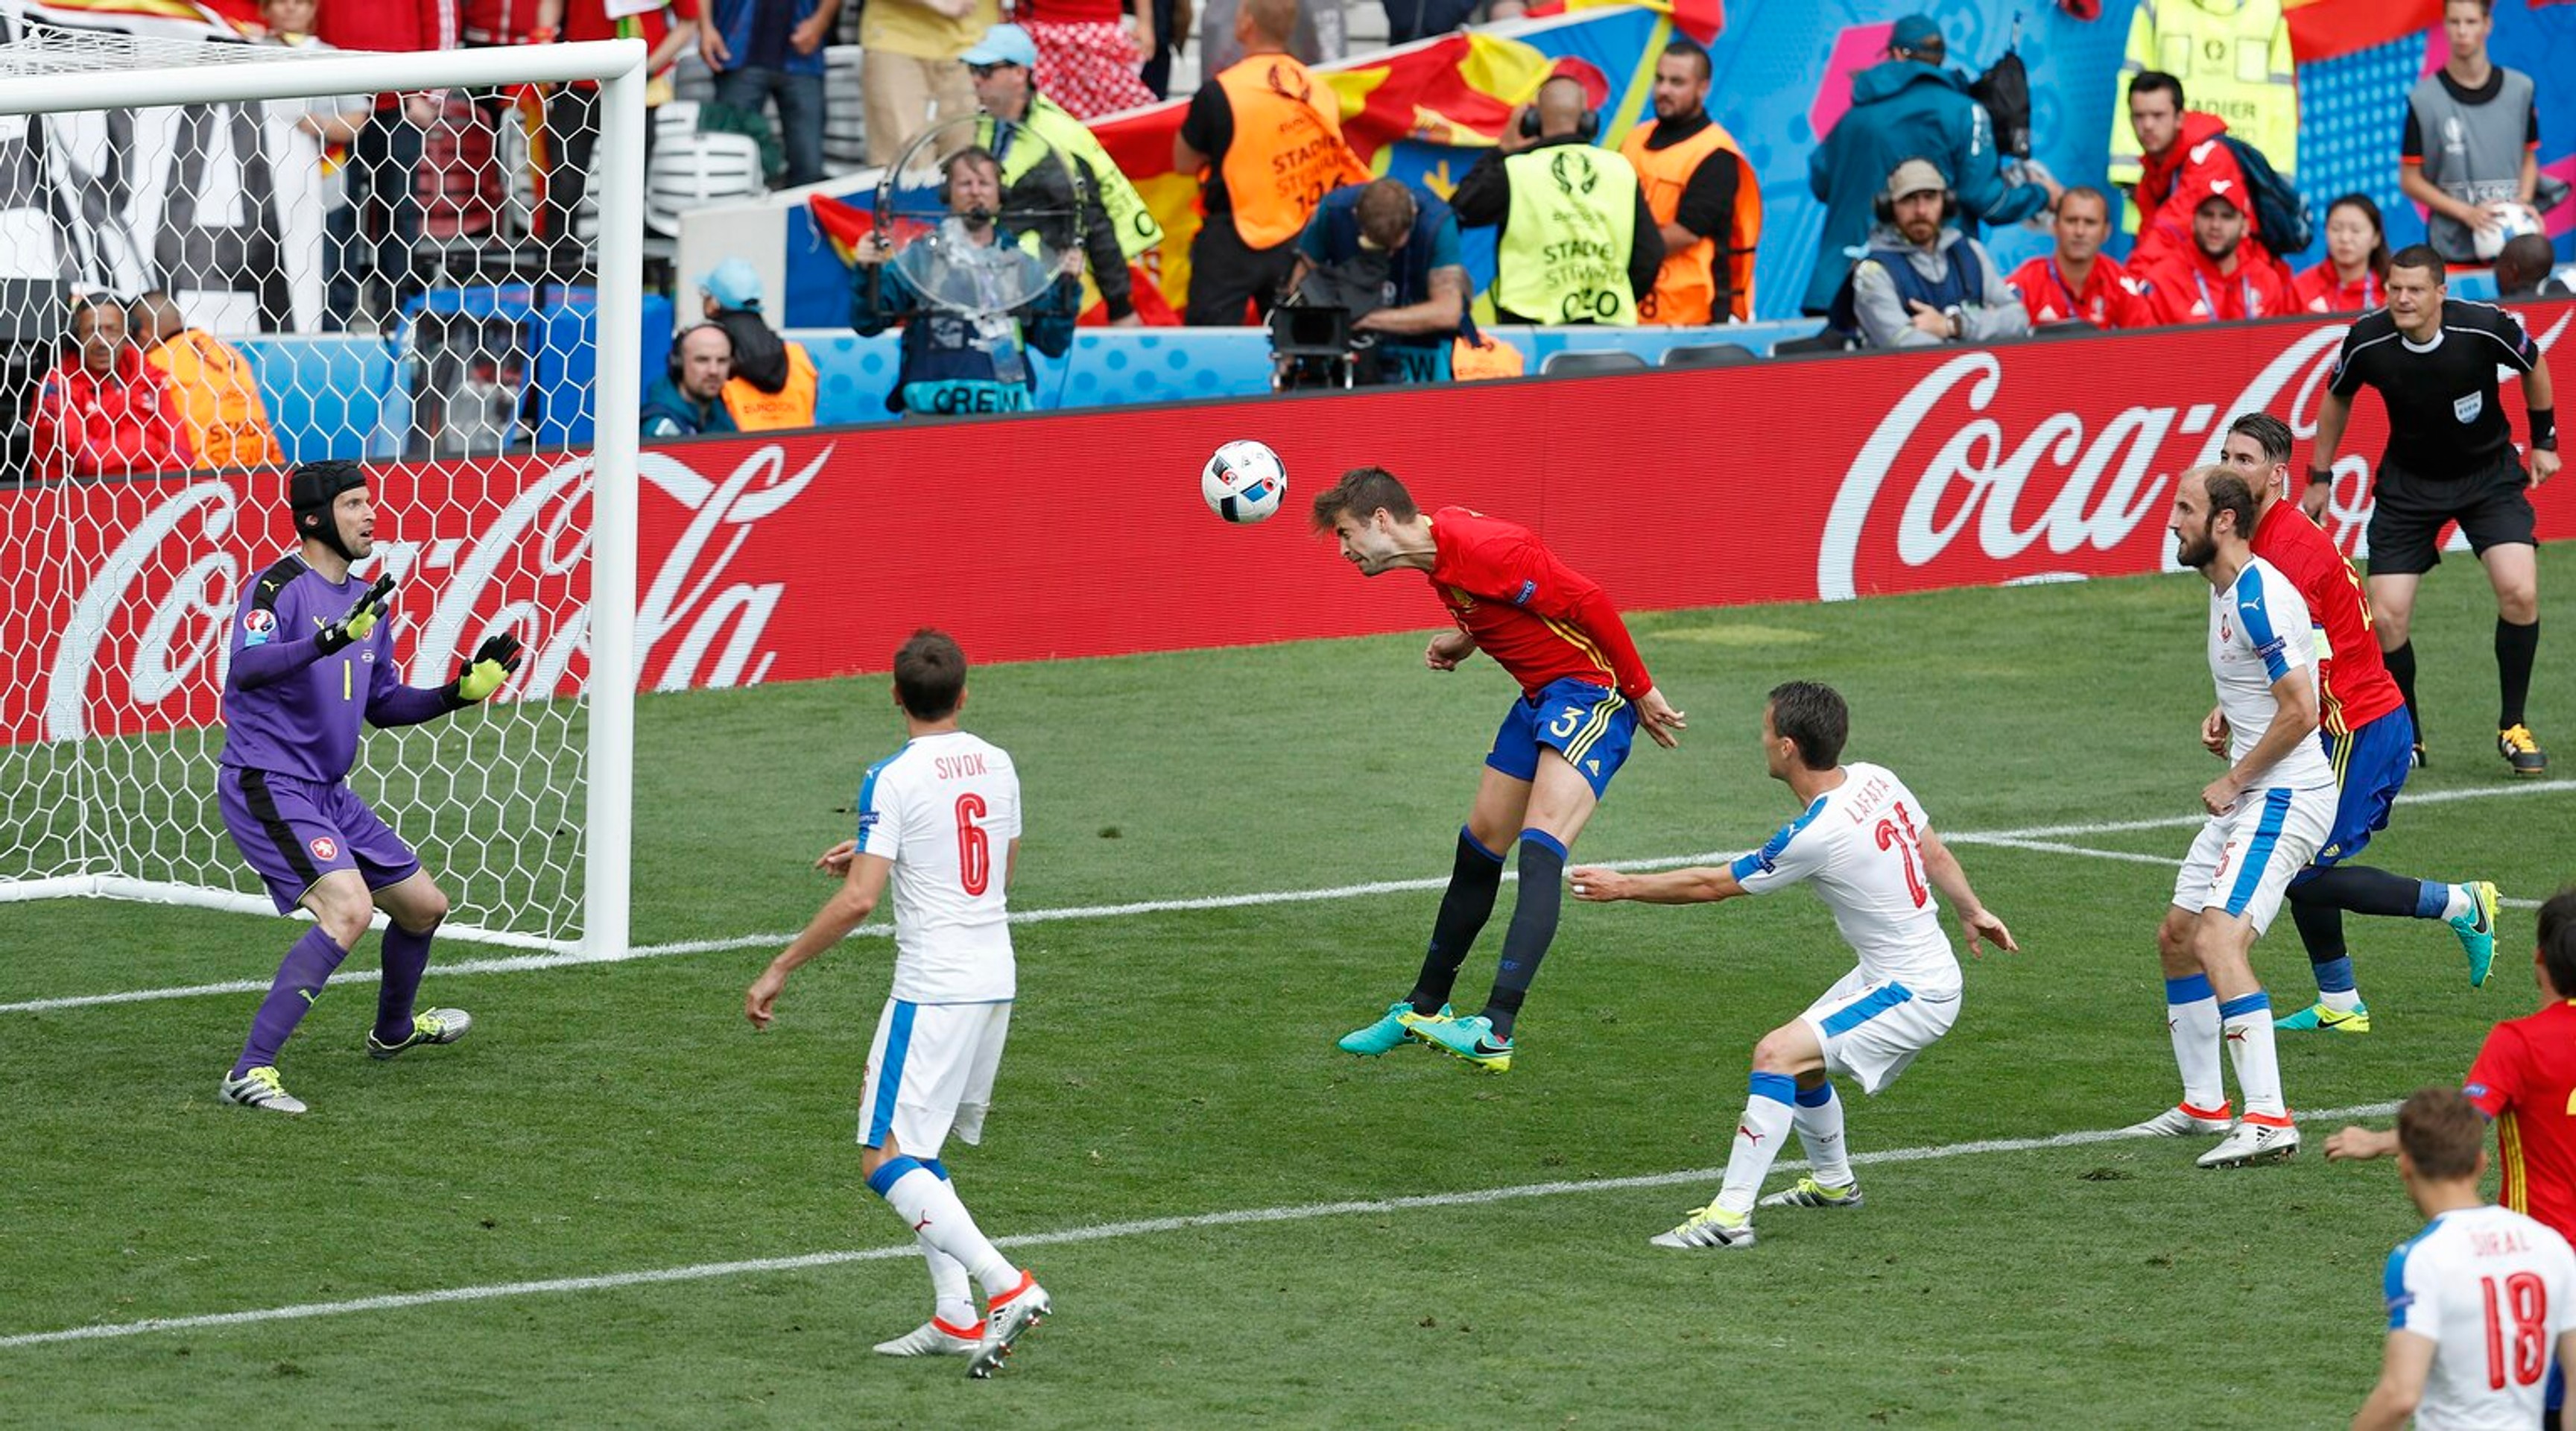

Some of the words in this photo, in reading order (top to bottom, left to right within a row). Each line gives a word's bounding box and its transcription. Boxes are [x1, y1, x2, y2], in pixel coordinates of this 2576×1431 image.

[934, 387, 1021, 415] CREW
[1550, 705, 1586, 738] 3
[935, 754, 987, 780] SIVOK
[1844, 775, 1890, 824] LAFATA
[955, 792, 990, 897] 6
[2480, 1272, 2548, 1391] 18
